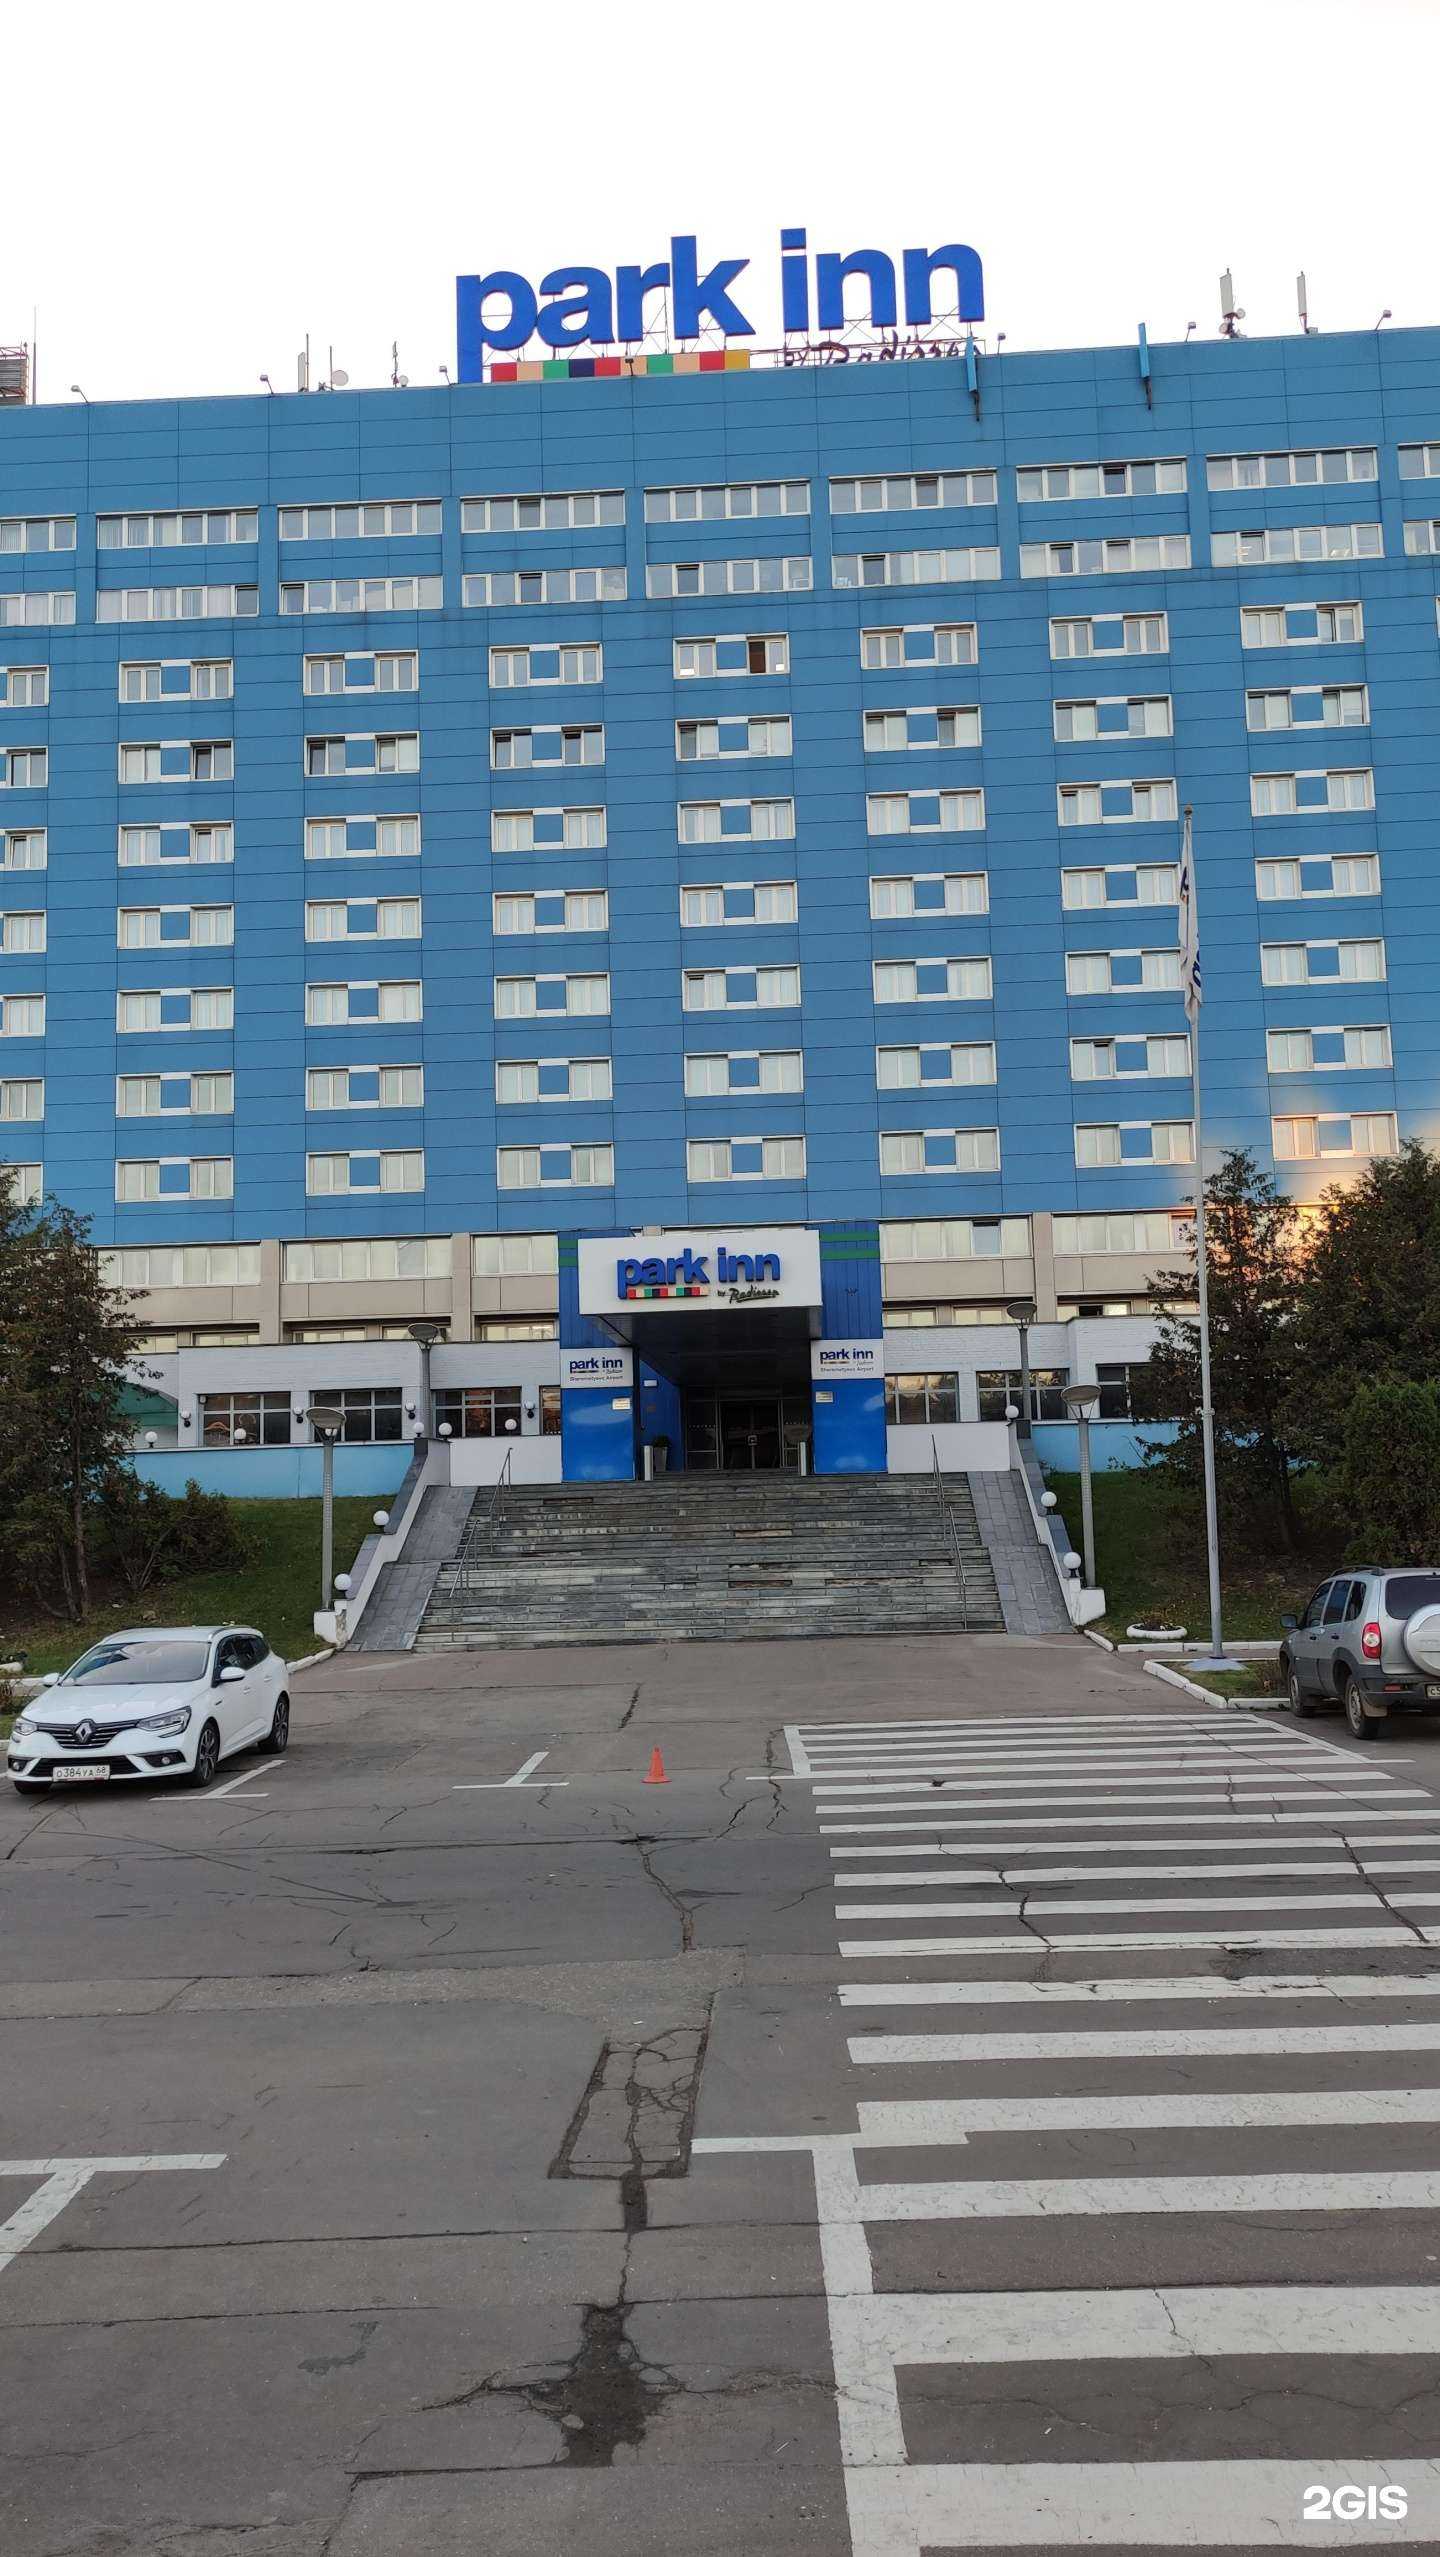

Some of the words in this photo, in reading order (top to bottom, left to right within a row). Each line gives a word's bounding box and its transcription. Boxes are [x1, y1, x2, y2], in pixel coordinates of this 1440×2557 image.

[456, 235, 756, 384] park
[780, 227, 985, 333] inn
[616, 1248, 711, 1300] park
[717, 1247, 781, 1283] inn
[569, 1357, 600, 1374] park
[602, 1356, 623, 1369] inn
[820, 1348, 850, 1365] park
[852, 1348, 874, 1360] inn
